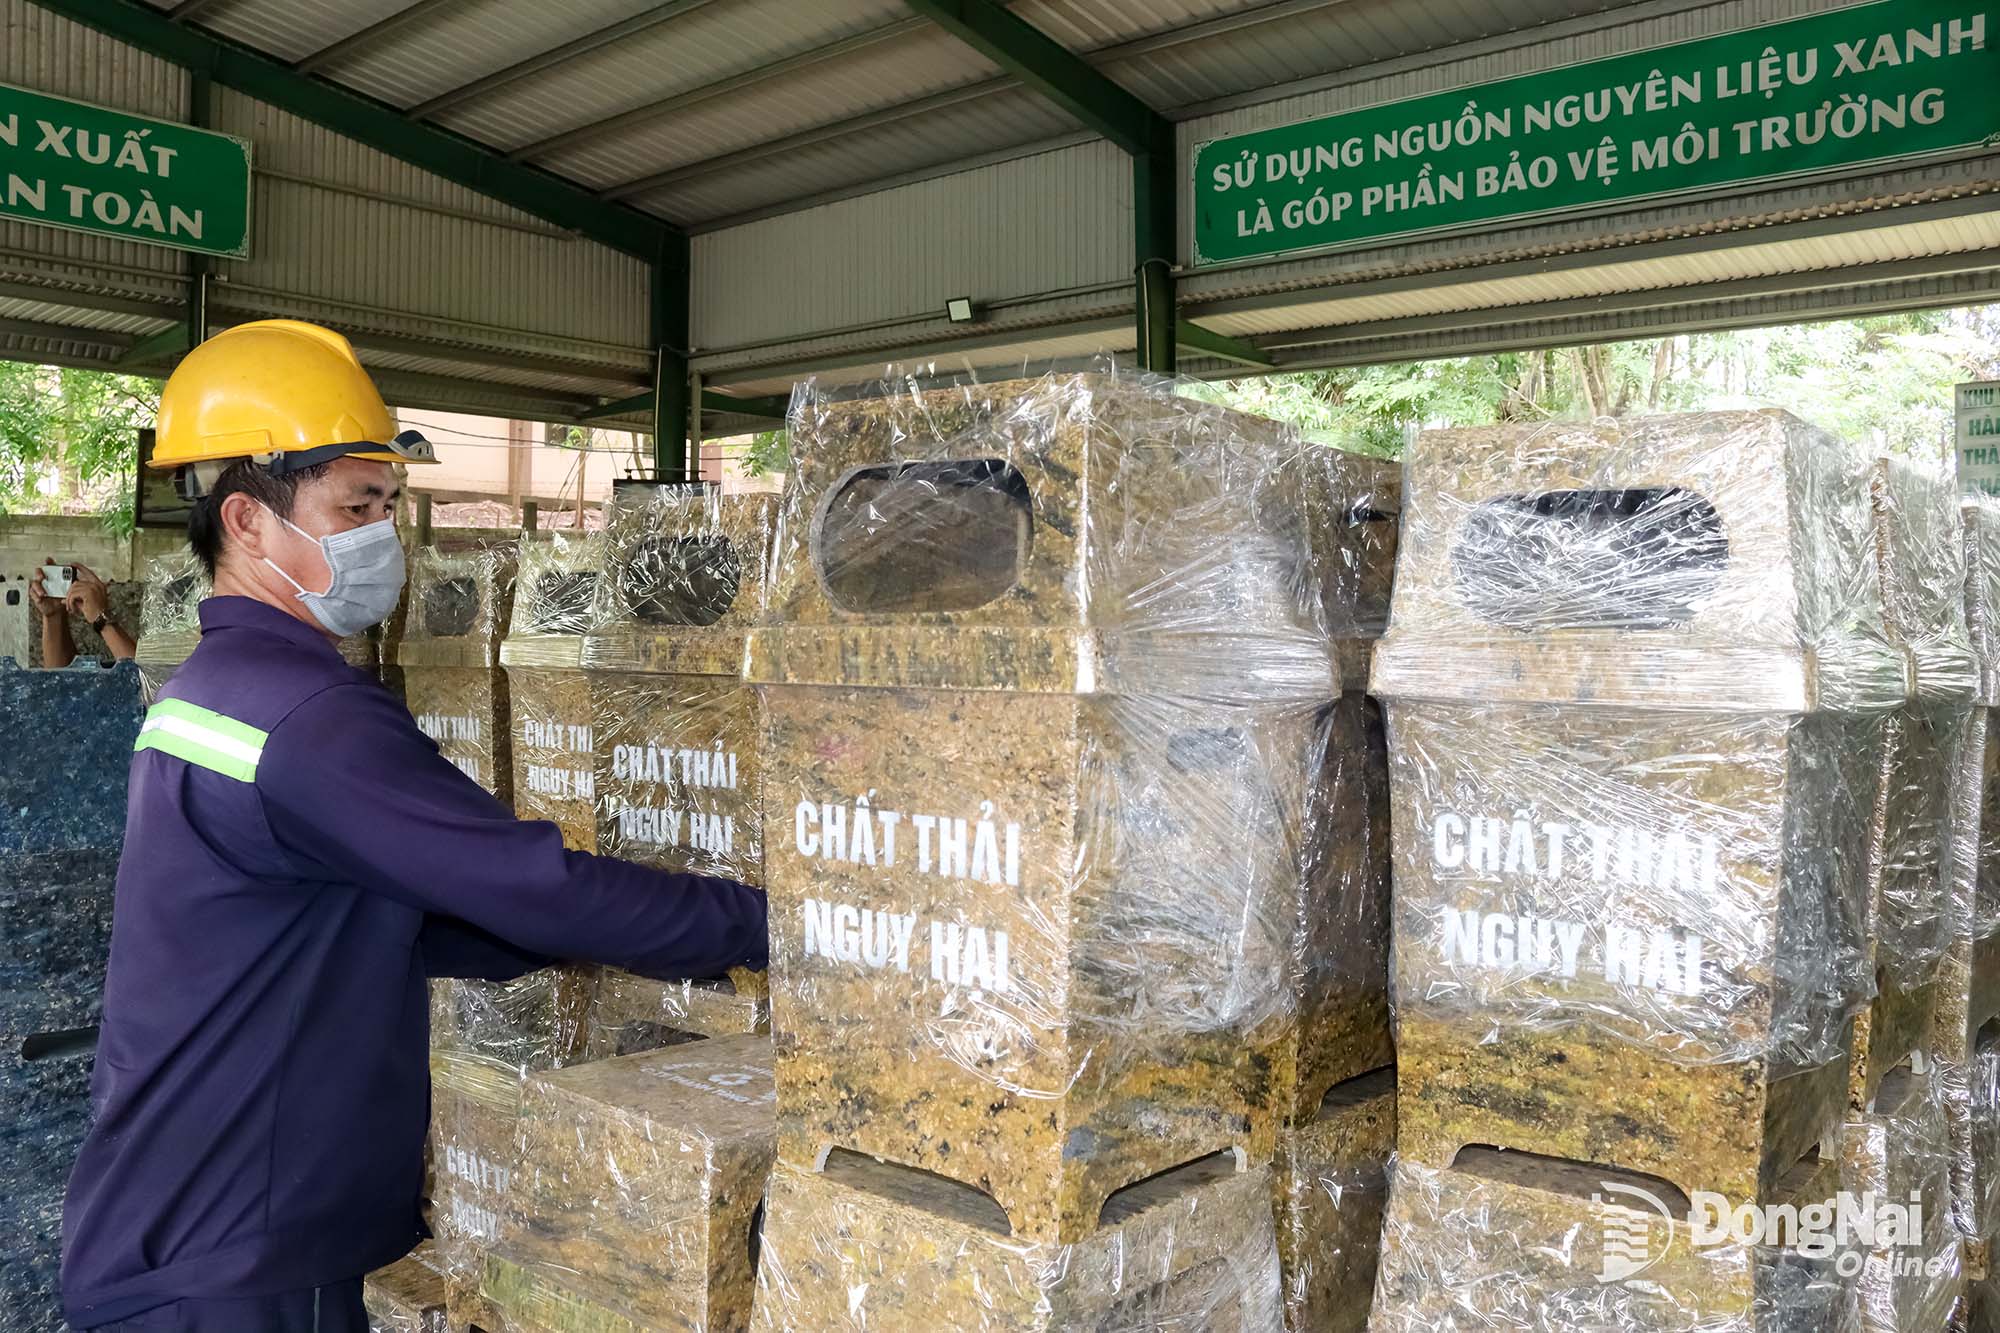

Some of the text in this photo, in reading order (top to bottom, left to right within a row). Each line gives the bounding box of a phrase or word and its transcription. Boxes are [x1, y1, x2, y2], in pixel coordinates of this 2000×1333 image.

[1213, 13, 1986, 192] SỬ DỤNG NGUỒN NGUYÊN LIỆU XANH
[35, 119, 178, 178] XUẤT
[1237, 88, 1945, 238] LÀ GÓP PHẦN BẢO VỆ MÔI TRƯỜNG
[61, 184, 203, 240] TOÀN
[680, 740, 737, 789] THẢI
[795, 788, 1021, 886] CHẤT THẢI
[804, 898, 917, 973] NGUY
[1444, 904, 1585, 979] NGUY
